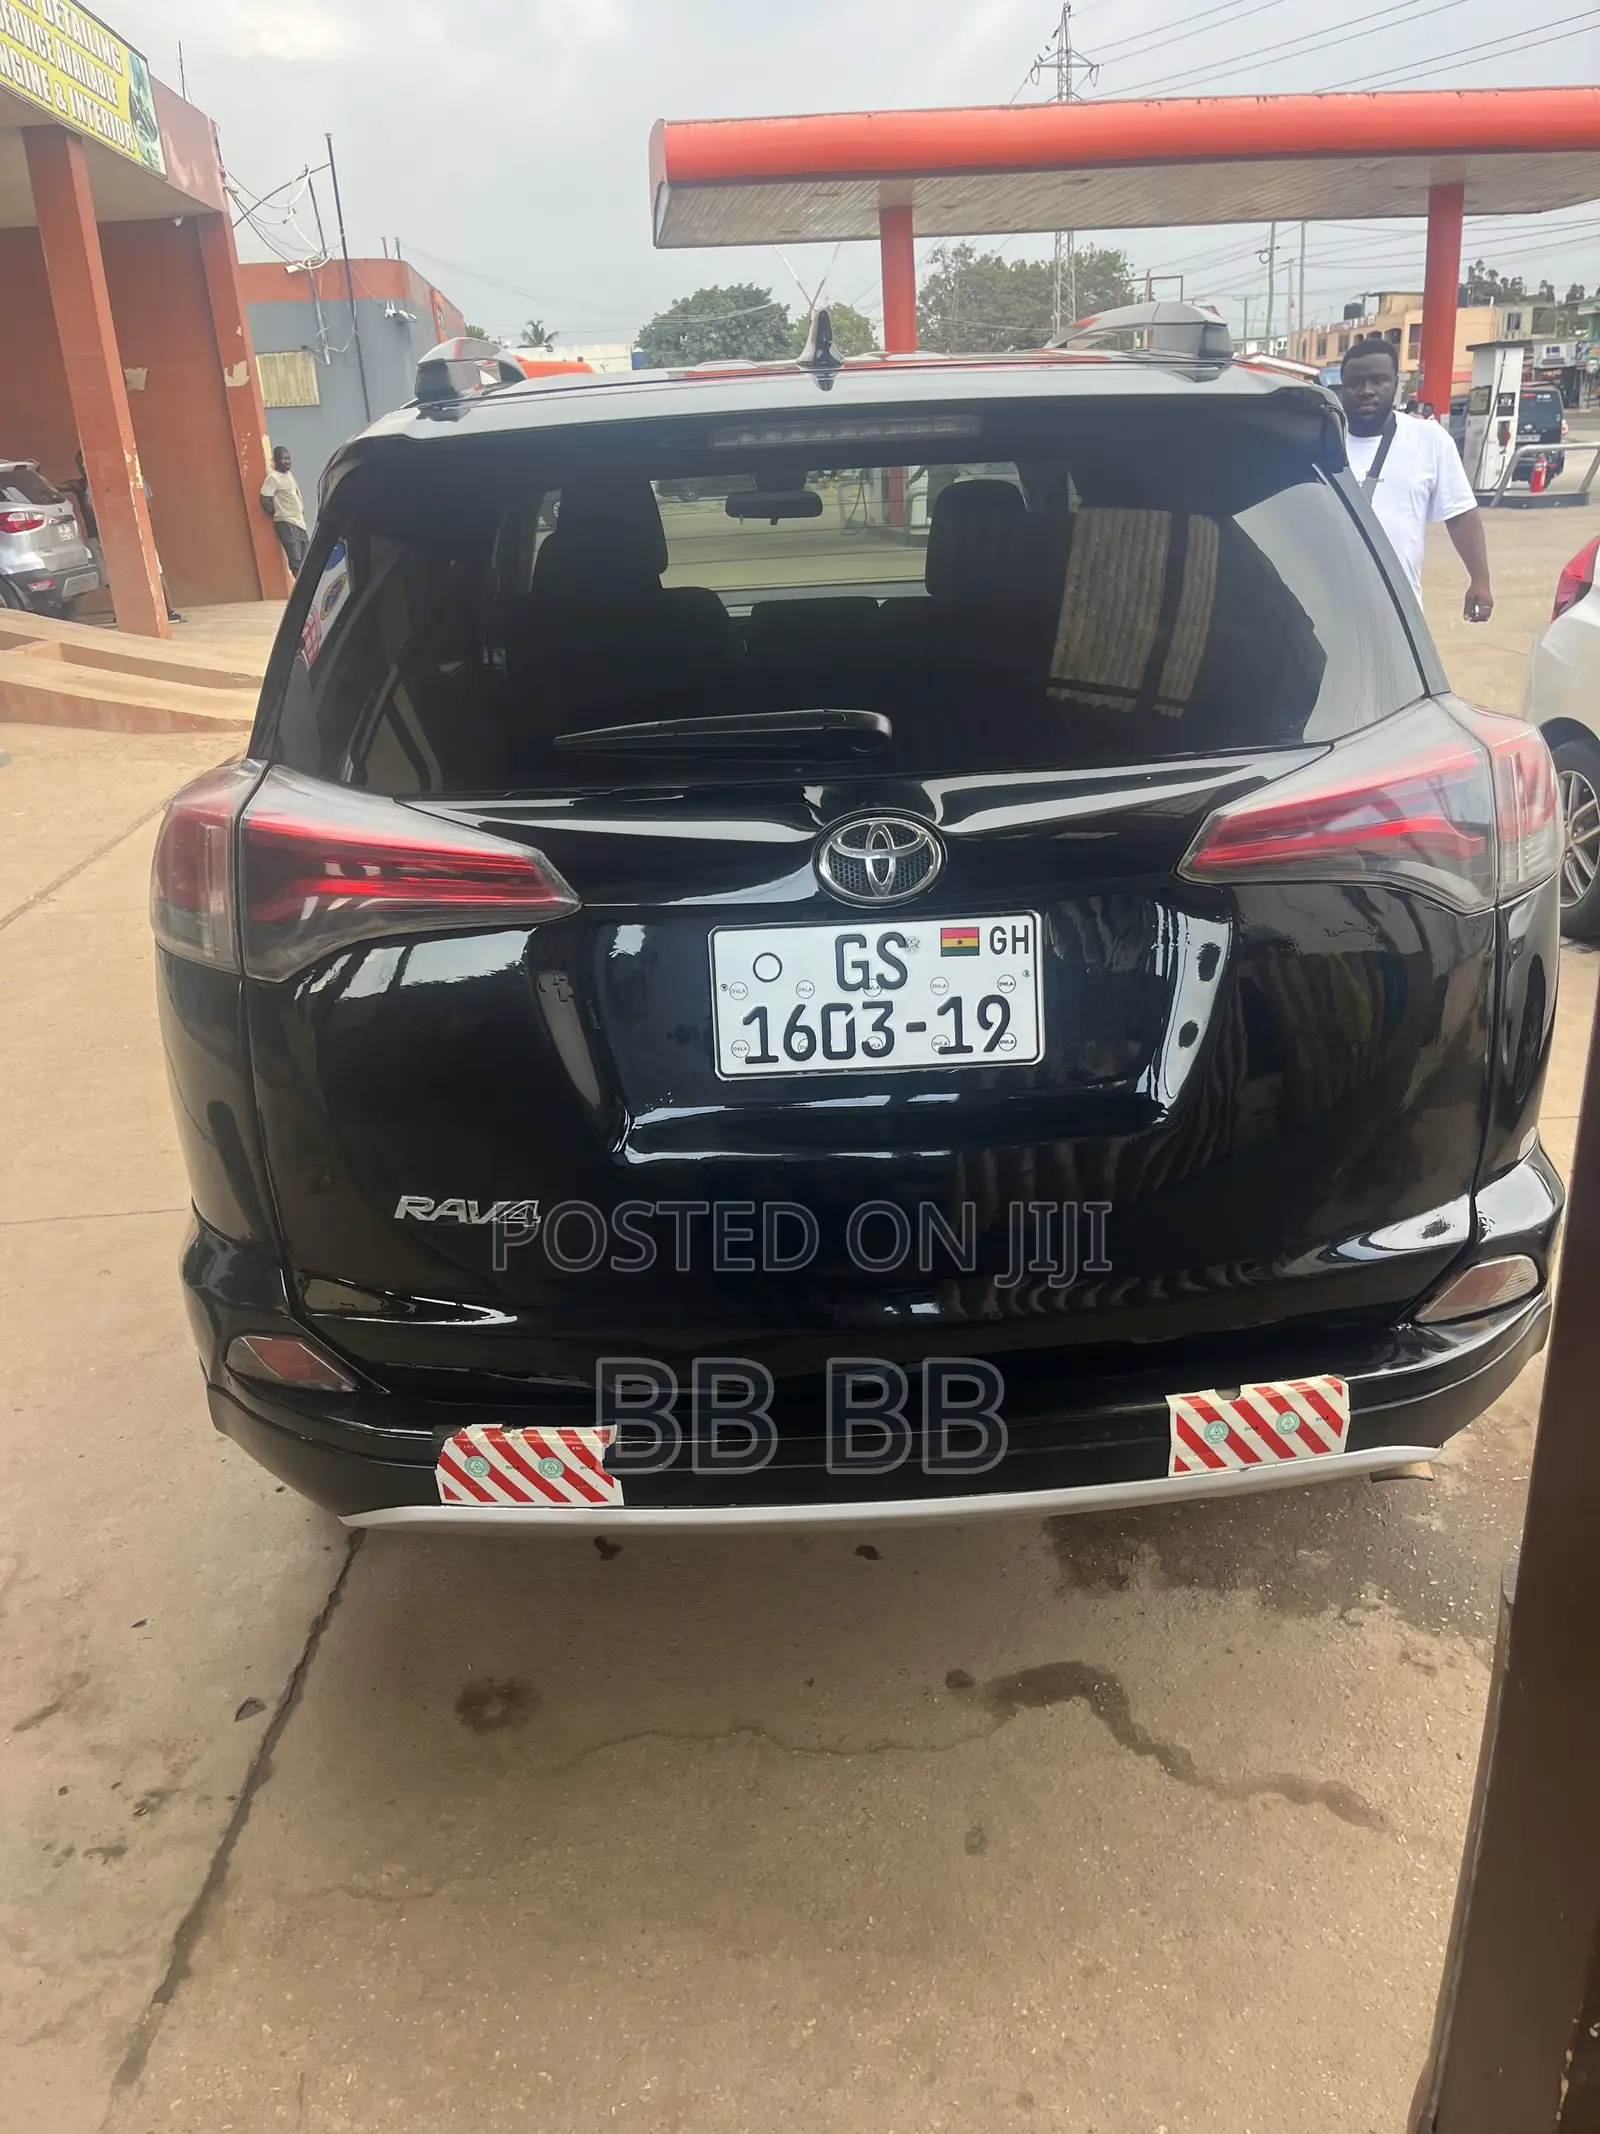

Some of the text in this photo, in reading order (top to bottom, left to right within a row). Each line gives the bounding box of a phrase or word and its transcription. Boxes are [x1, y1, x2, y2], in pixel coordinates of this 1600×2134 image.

[0, 39, 53, 106] NGINE
[68, 83, 136, 155] INTERIOR
[54, 36, 120, 109] AVAILABLE
[834, 931, 909, 992] GS
[988, 925, 1029, 956] GH
[742, 994, 1011, 1065] 1603-19
[394, 1195, 542, 1227] RAV4
